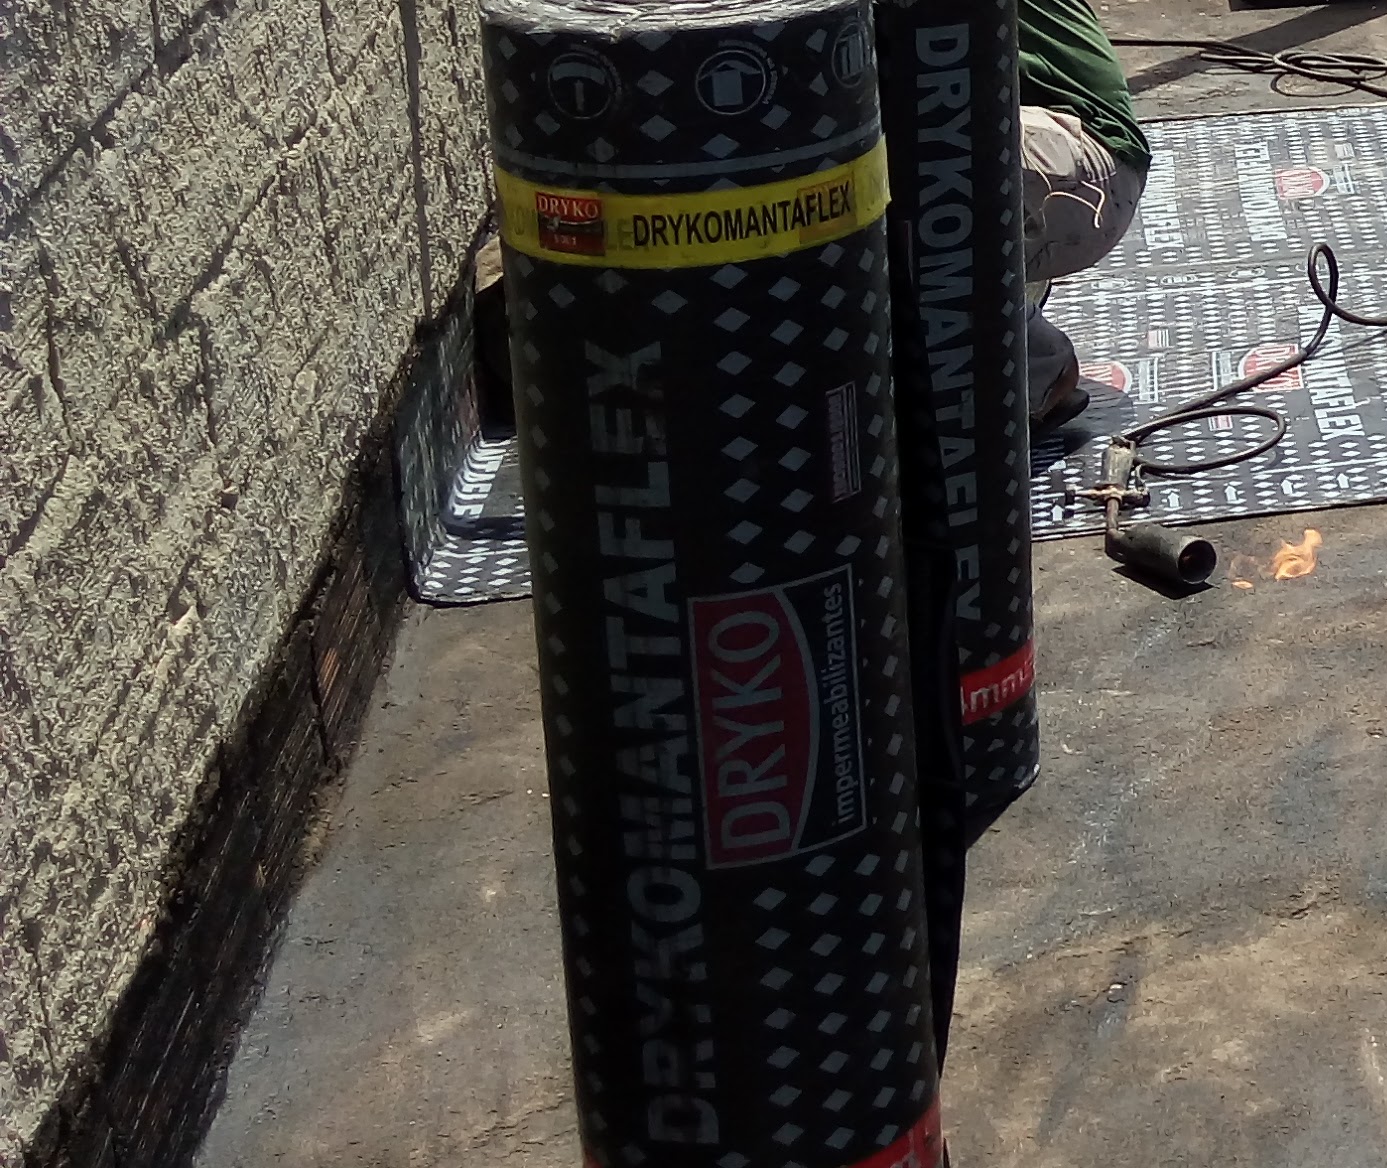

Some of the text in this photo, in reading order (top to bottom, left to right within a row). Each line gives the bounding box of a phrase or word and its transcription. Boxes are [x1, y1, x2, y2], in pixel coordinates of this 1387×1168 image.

[537, 194, 599, 219] DRYKO
[633, 181, 852, 247] DRYKOMANTAFLEX
[585, 341, 719, 1146] DRYKOMANTAFLEX
[708, 610, 790, 849] DRYKO
[819, 582, 858, 826] impermeabilizantes
